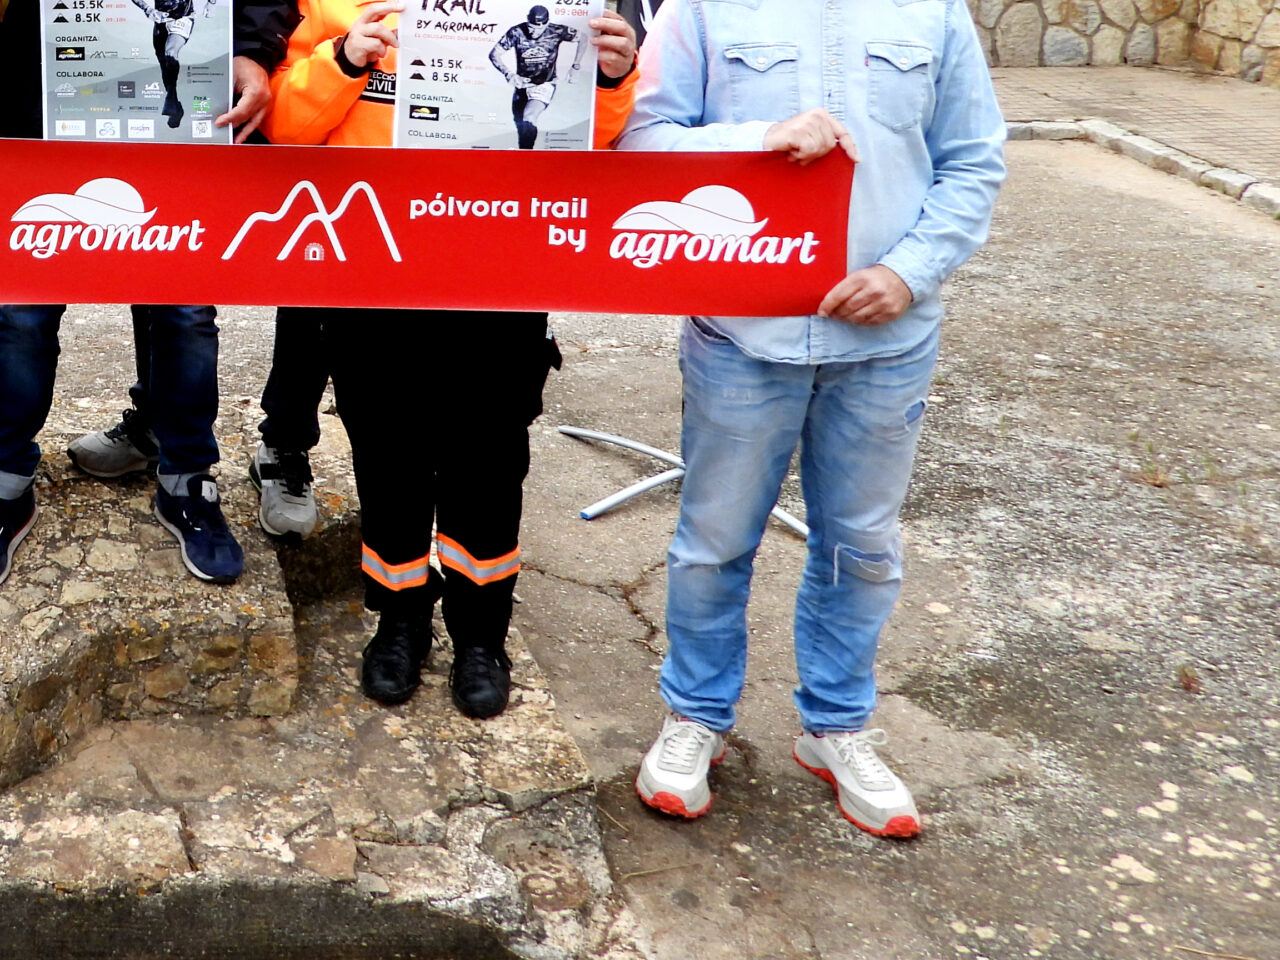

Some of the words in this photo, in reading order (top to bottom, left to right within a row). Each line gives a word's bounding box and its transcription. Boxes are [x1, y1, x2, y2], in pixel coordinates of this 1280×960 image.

[72, 0, 104, 10] 15.5K
[75, 13, 101, 23] 8.5K
[416, 20, 431, 29] BY
[434, 21, 498, 33] AGROMART
[366, 79, 396, 93] CIVIL
[409, 192, 520, 220] pólvora
[529, 196, 588, 218] trail
[9, 219, 206, 259] agromart
[548, 224, 587, 253] by
[609, 229, 820, 269] agromart
